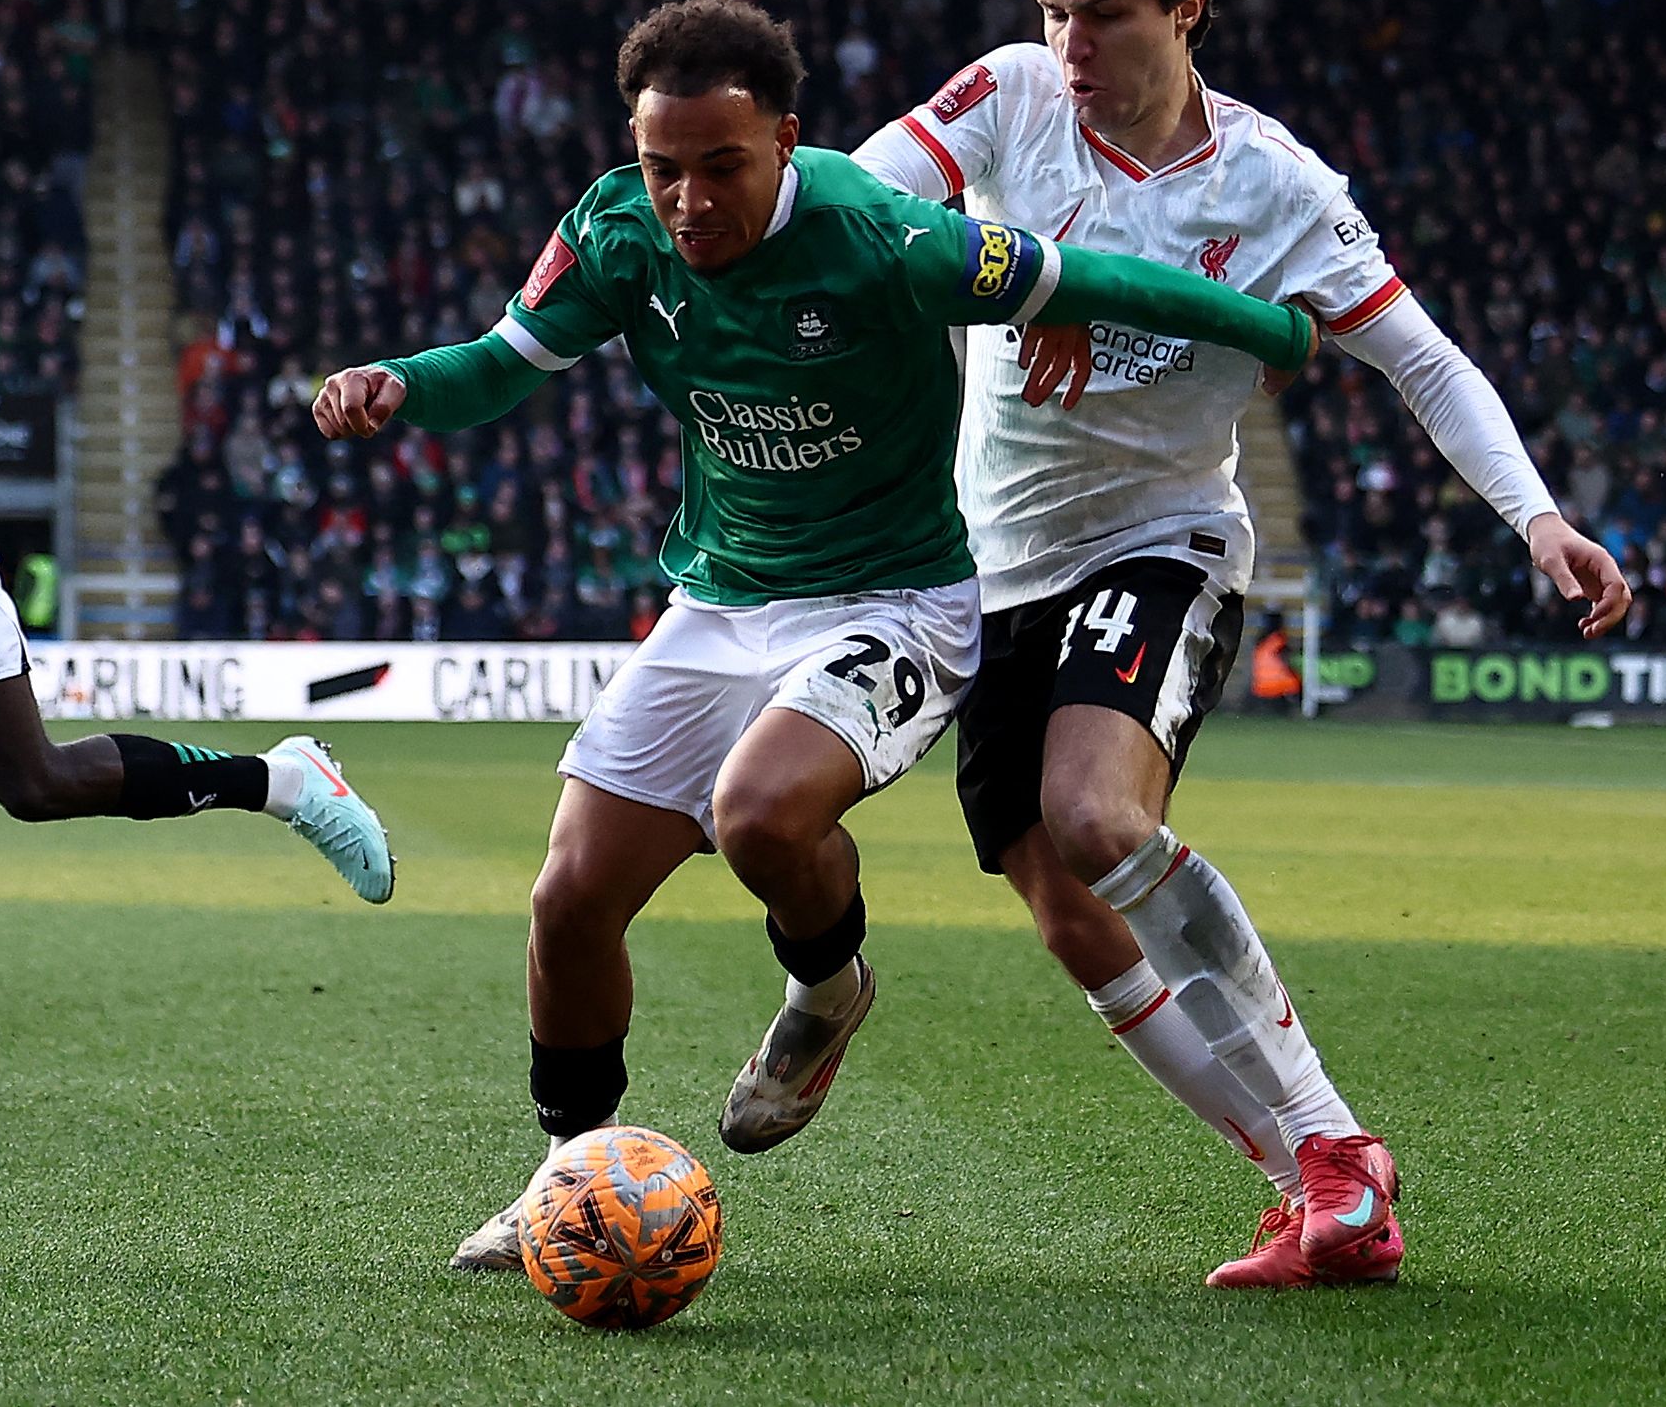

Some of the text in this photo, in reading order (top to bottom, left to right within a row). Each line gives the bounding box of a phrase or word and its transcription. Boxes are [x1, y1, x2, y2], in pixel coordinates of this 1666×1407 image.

[1087, 322, 1195, 372] andard
[1091, 351, 1172, 386] arter
[688, 390, 834, 432] Classic
[693, 416, 863, 472] Builders
[433, 657, 621, 719] CARLIN
[823, 633, 927, 730] 29
